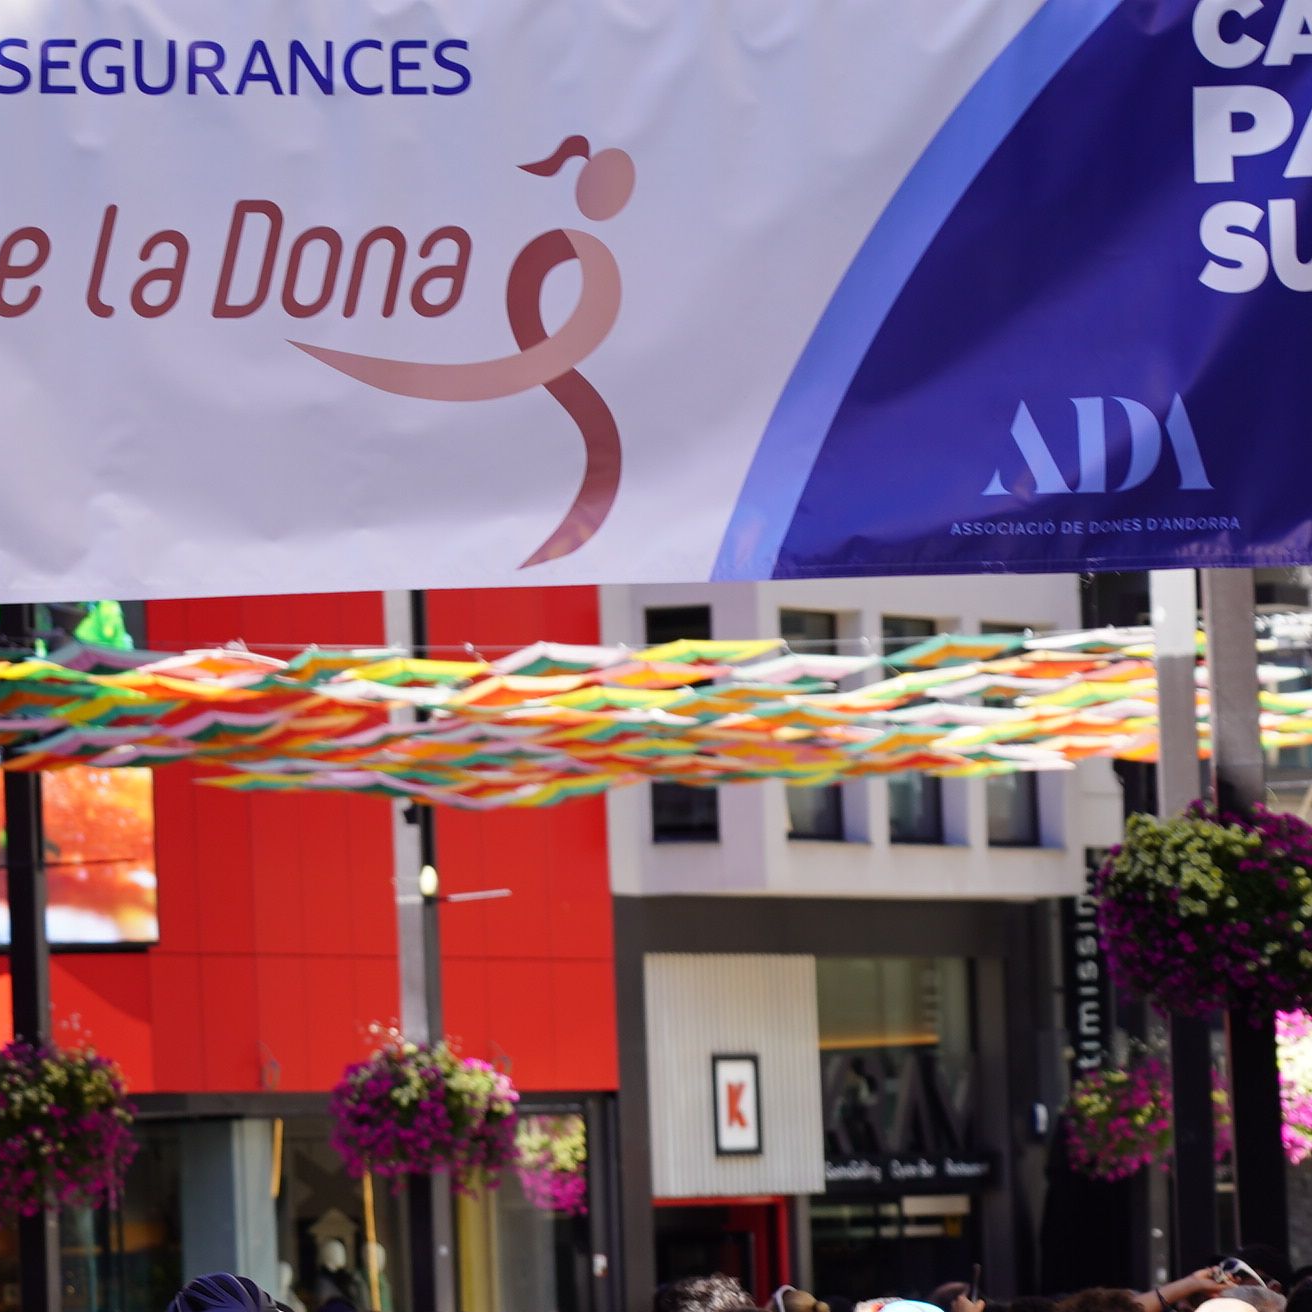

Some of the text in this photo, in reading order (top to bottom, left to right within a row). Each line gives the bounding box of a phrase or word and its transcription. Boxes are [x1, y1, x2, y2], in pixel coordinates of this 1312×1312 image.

[86, 203, 190, 319] la
[211, 199, 473, 320] Dona
[980, 392, 1215, 496] ADA
[950, 516, 1241, 536] ASSOCIACIÓ DE DONES D'ANDORRA
[726, 1082, 749, 1128] K
